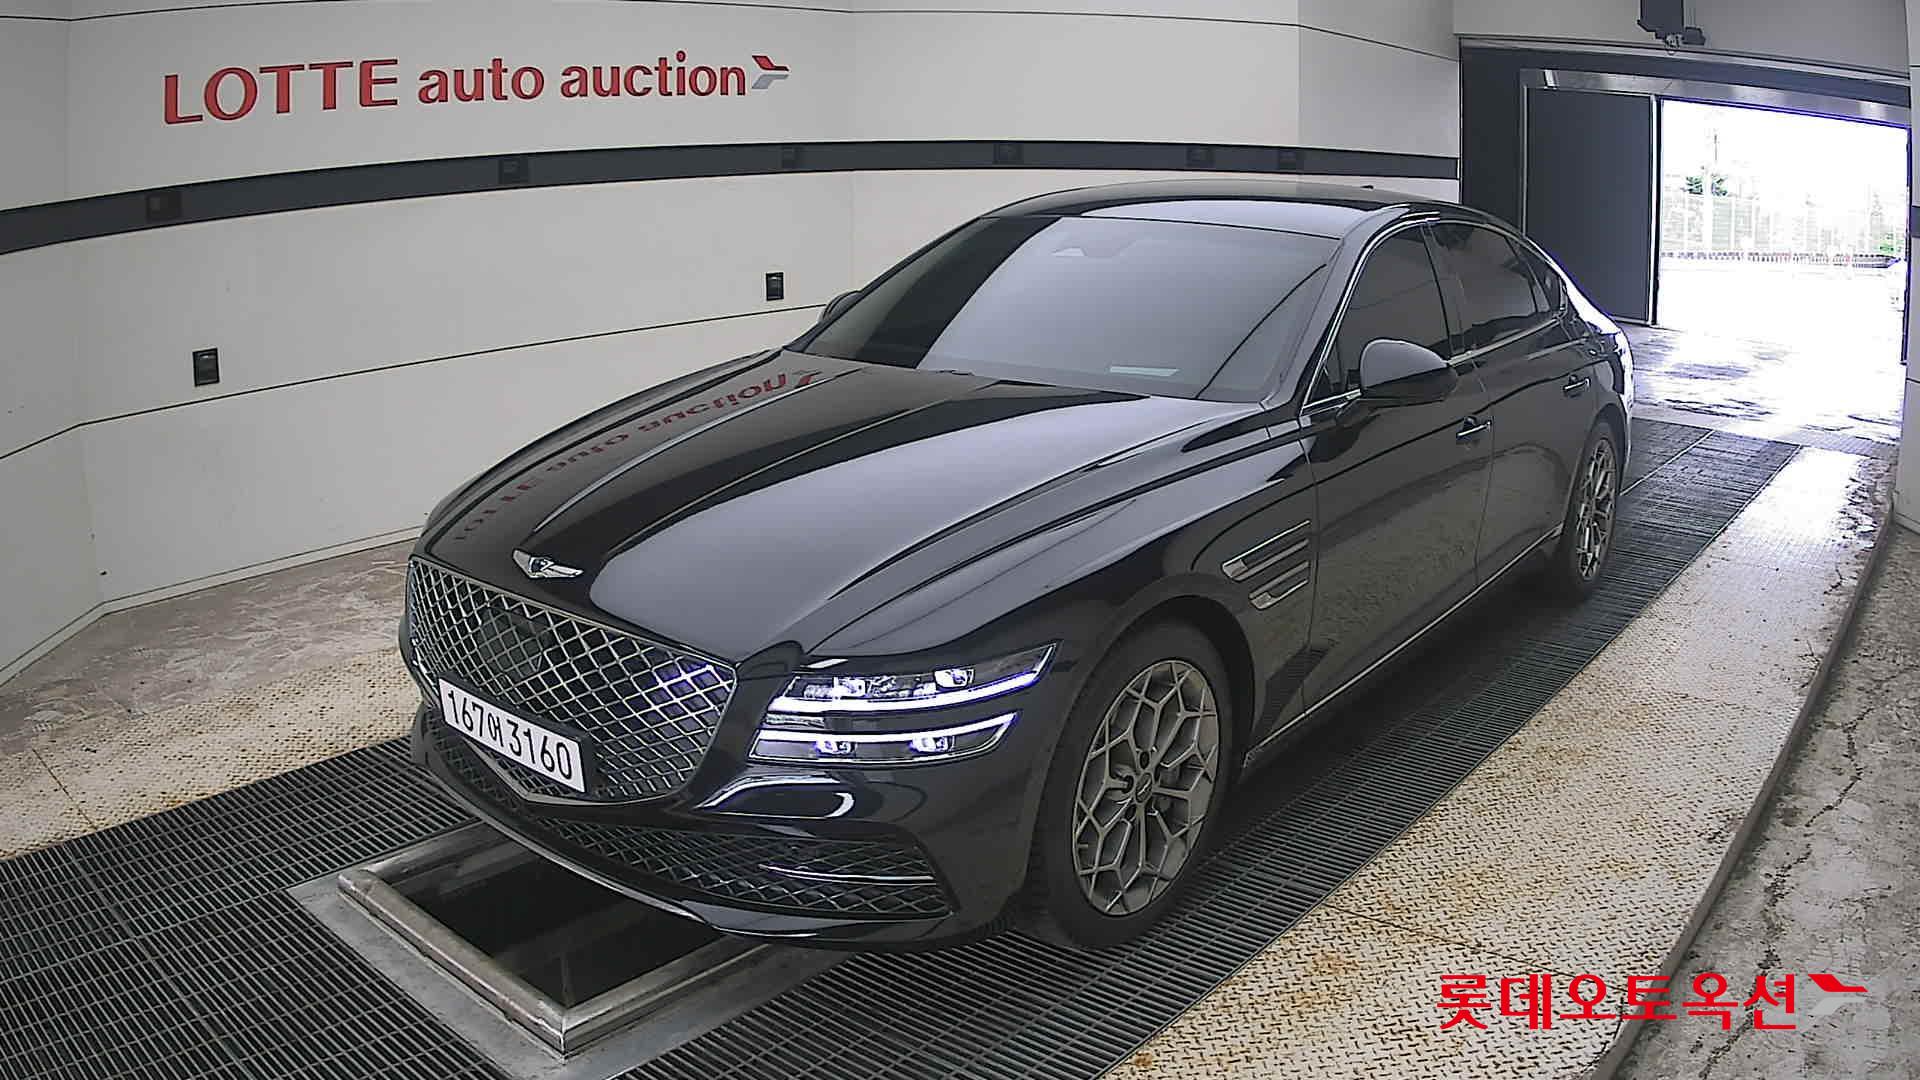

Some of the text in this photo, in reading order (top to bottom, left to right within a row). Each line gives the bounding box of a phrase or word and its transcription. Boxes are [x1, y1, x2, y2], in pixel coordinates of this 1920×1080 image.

[163, 50, 747, 125] LOTTE auto auction
[447, 689, 573, 781] 167어3160
